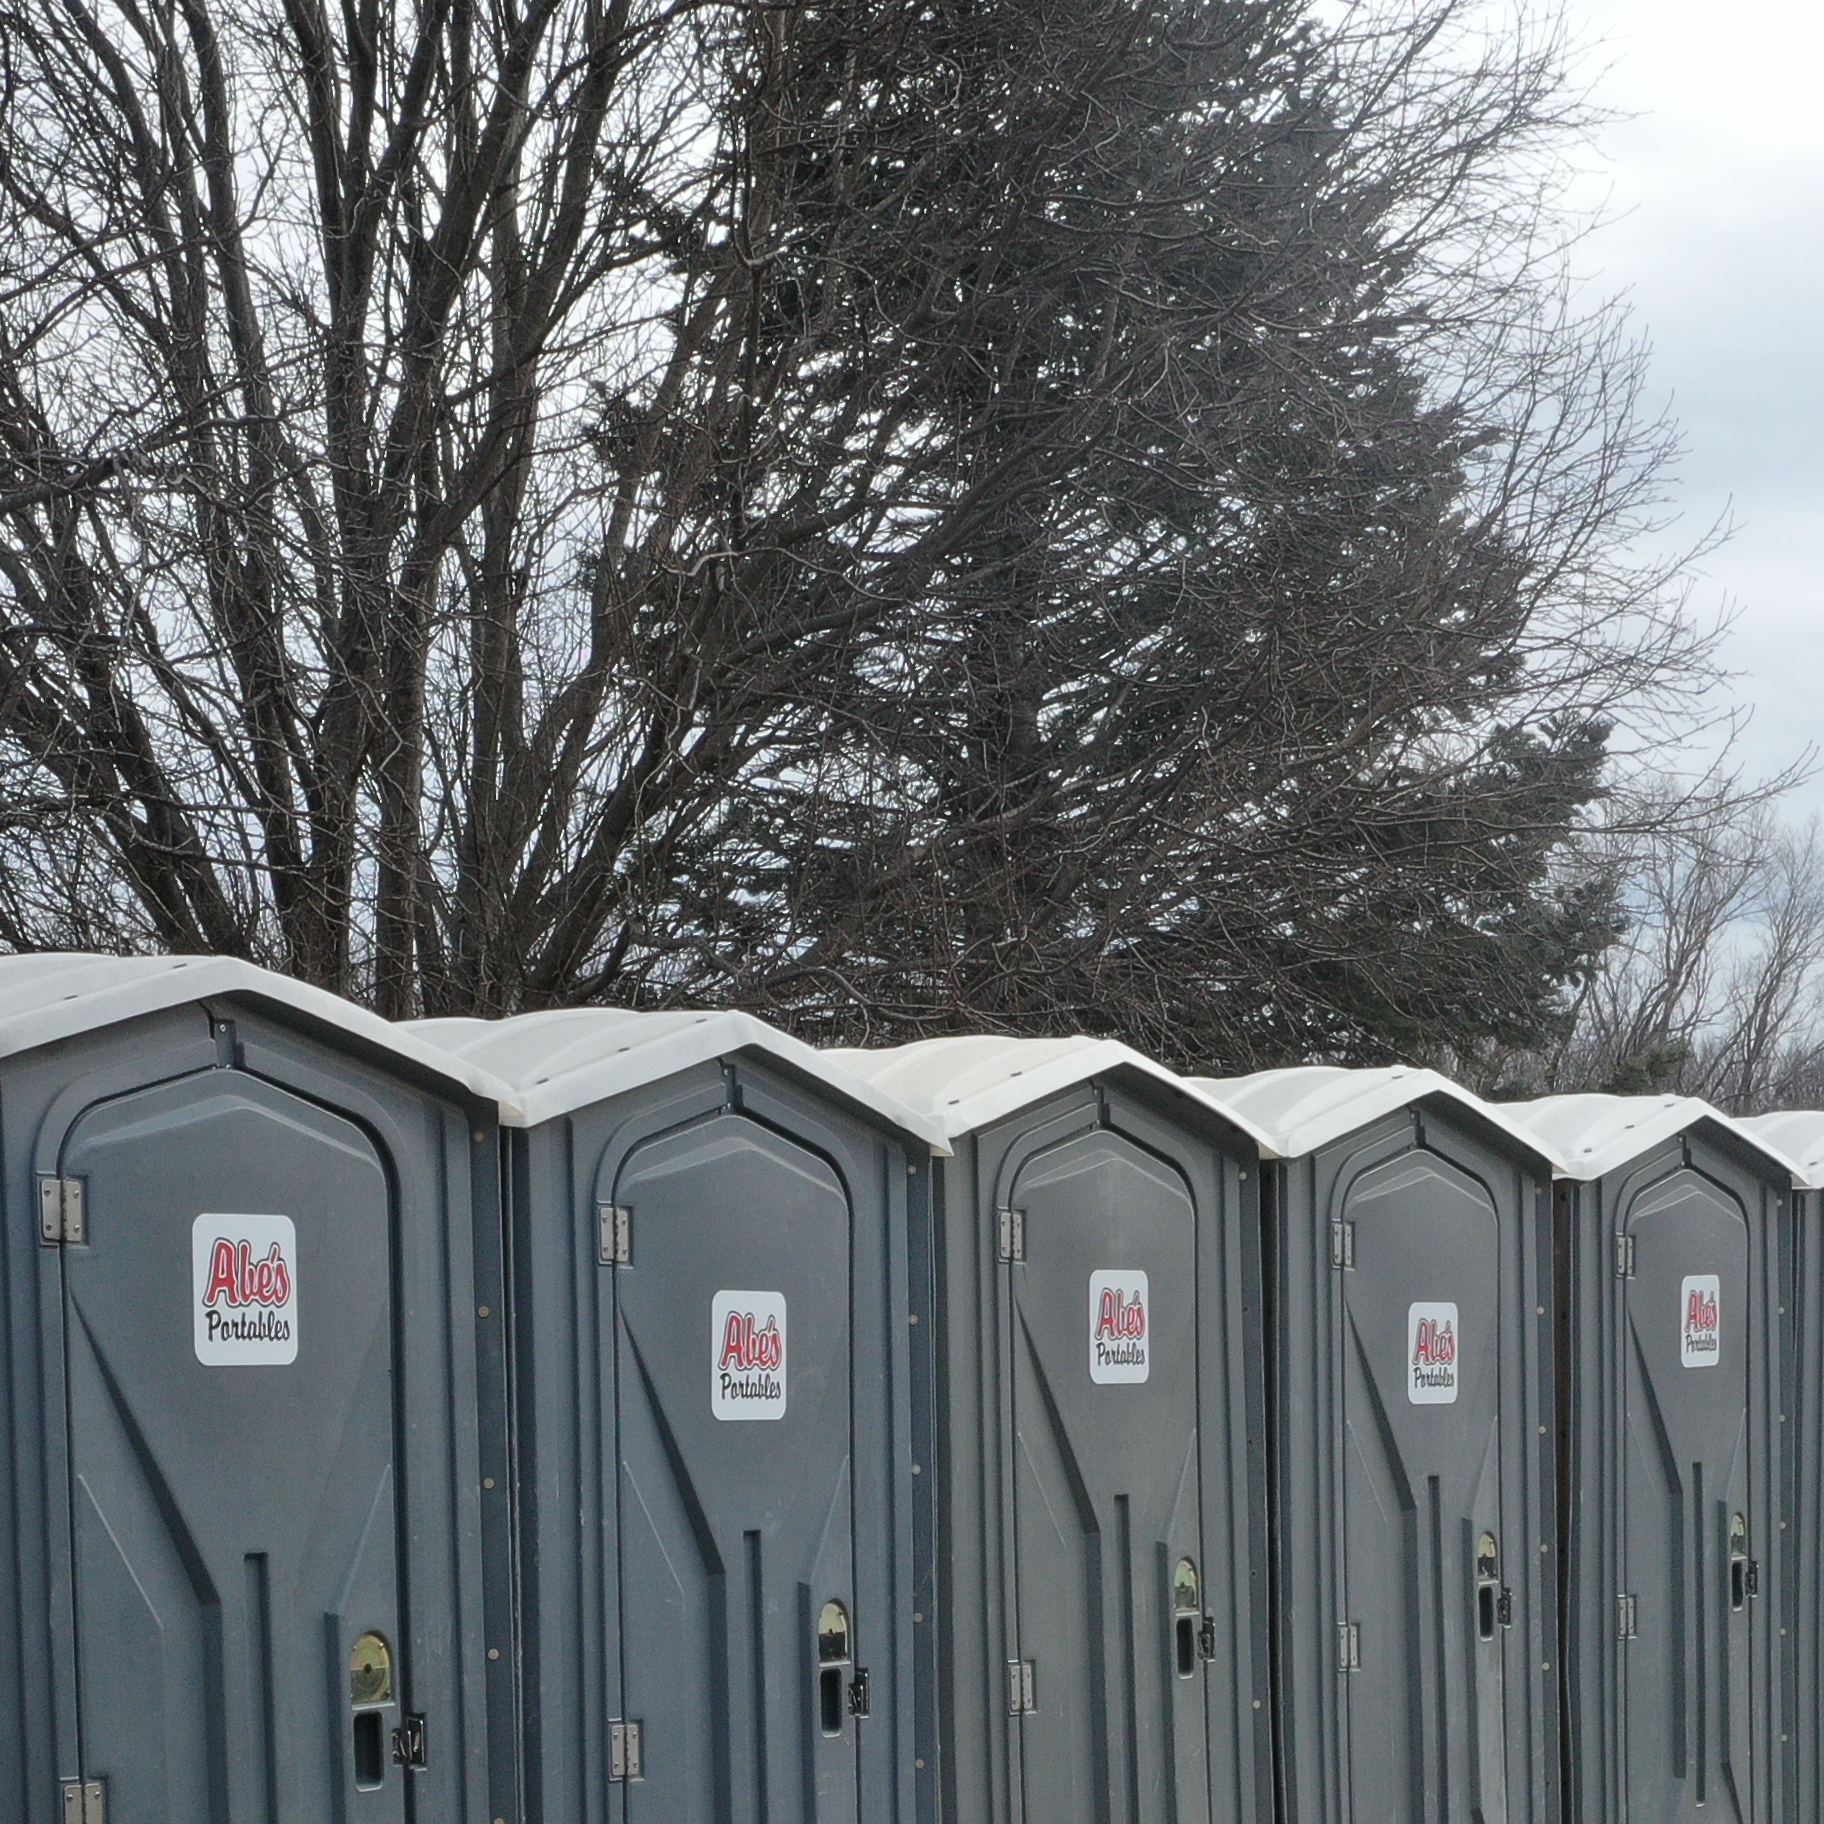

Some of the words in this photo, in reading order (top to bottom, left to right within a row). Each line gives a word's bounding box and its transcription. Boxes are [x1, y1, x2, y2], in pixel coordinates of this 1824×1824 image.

[202, 1237, 291, 1308] Abe's
[205, 1310, 290, 1342] Portables
[1094, 1287, 1145, 1341] Abe's
[1684, 1289, 1717, 1333] Abe's
[718, 1310, 782, 1371] Abe's
[1096, 1342, 1145, 1366] Portables
[1412, 1318, 1455, 1366] Abe's
[720, 1373, 781, 1401] Portables
